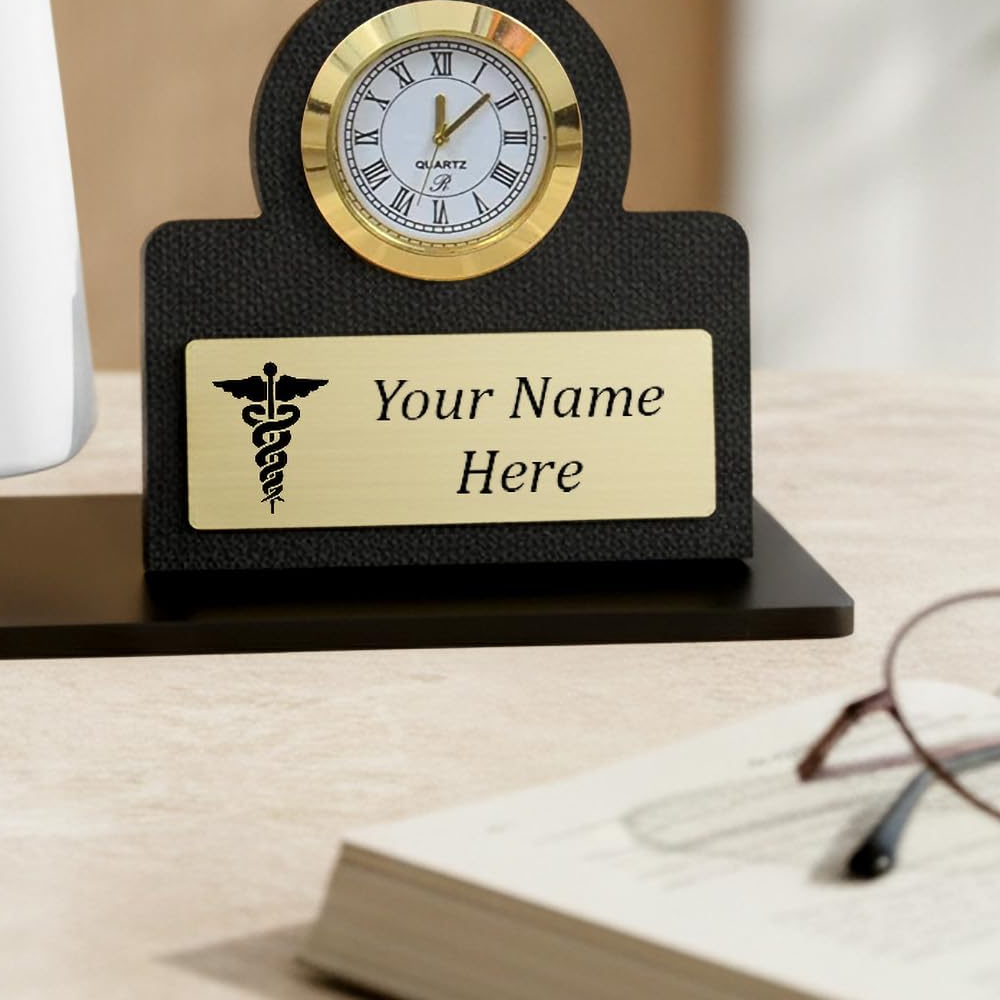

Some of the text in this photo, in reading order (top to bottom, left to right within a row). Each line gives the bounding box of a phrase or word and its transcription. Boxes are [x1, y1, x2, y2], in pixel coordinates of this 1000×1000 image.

[389, 60, 415, 89] XI
[431, 51, 453, 76] XII
[471, 62, 488, 84] I
[363, 90, 390, 111] X
[494, 91, 520, 111] II
[354, 130, 379, 146] IX
[503, 130, 528, 145] III
[361, 158, 392, 191] VIII
[415, 160, 467, 170] QUARTZ
[390, 186, 416, 217] VII
[433, 199, 449, 224] VI
[472, 191, 490, 215] V
[374, 376, 665, 421] Your Name
[456, 450, 584, 495] Here
